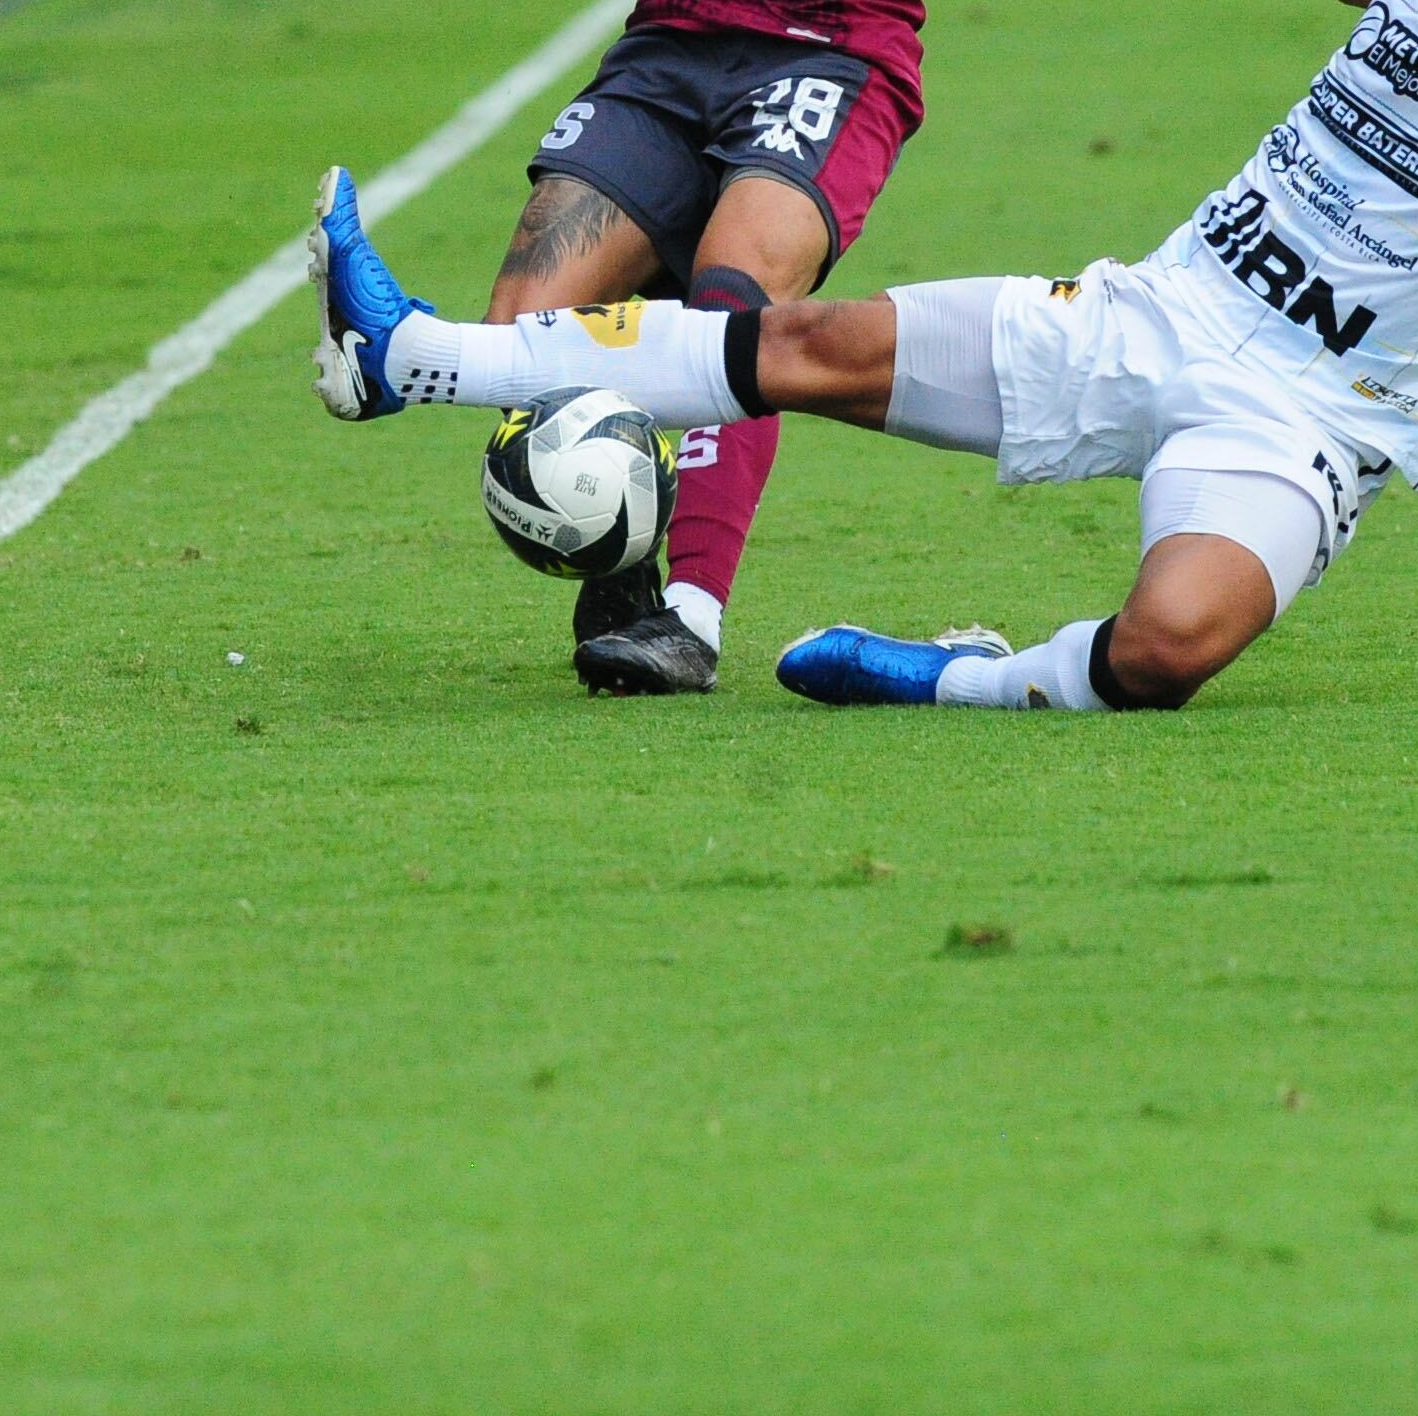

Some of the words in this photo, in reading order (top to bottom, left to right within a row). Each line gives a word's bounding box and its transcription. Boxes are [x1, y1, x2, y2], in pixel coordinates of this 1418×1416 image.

[1367, 43, 1382, 64] El
[541, 102, 596, 150] S
[749, 76, 845, 142] 28
[1313, 82, 1360, 131] SUPER
[1287, 171, 1306, 197] San
[1307, 191, 1352, 230] Rafael
[1299, 153, 1367, 211] Hospital
[484, 485, 533, 535] PIONEER
